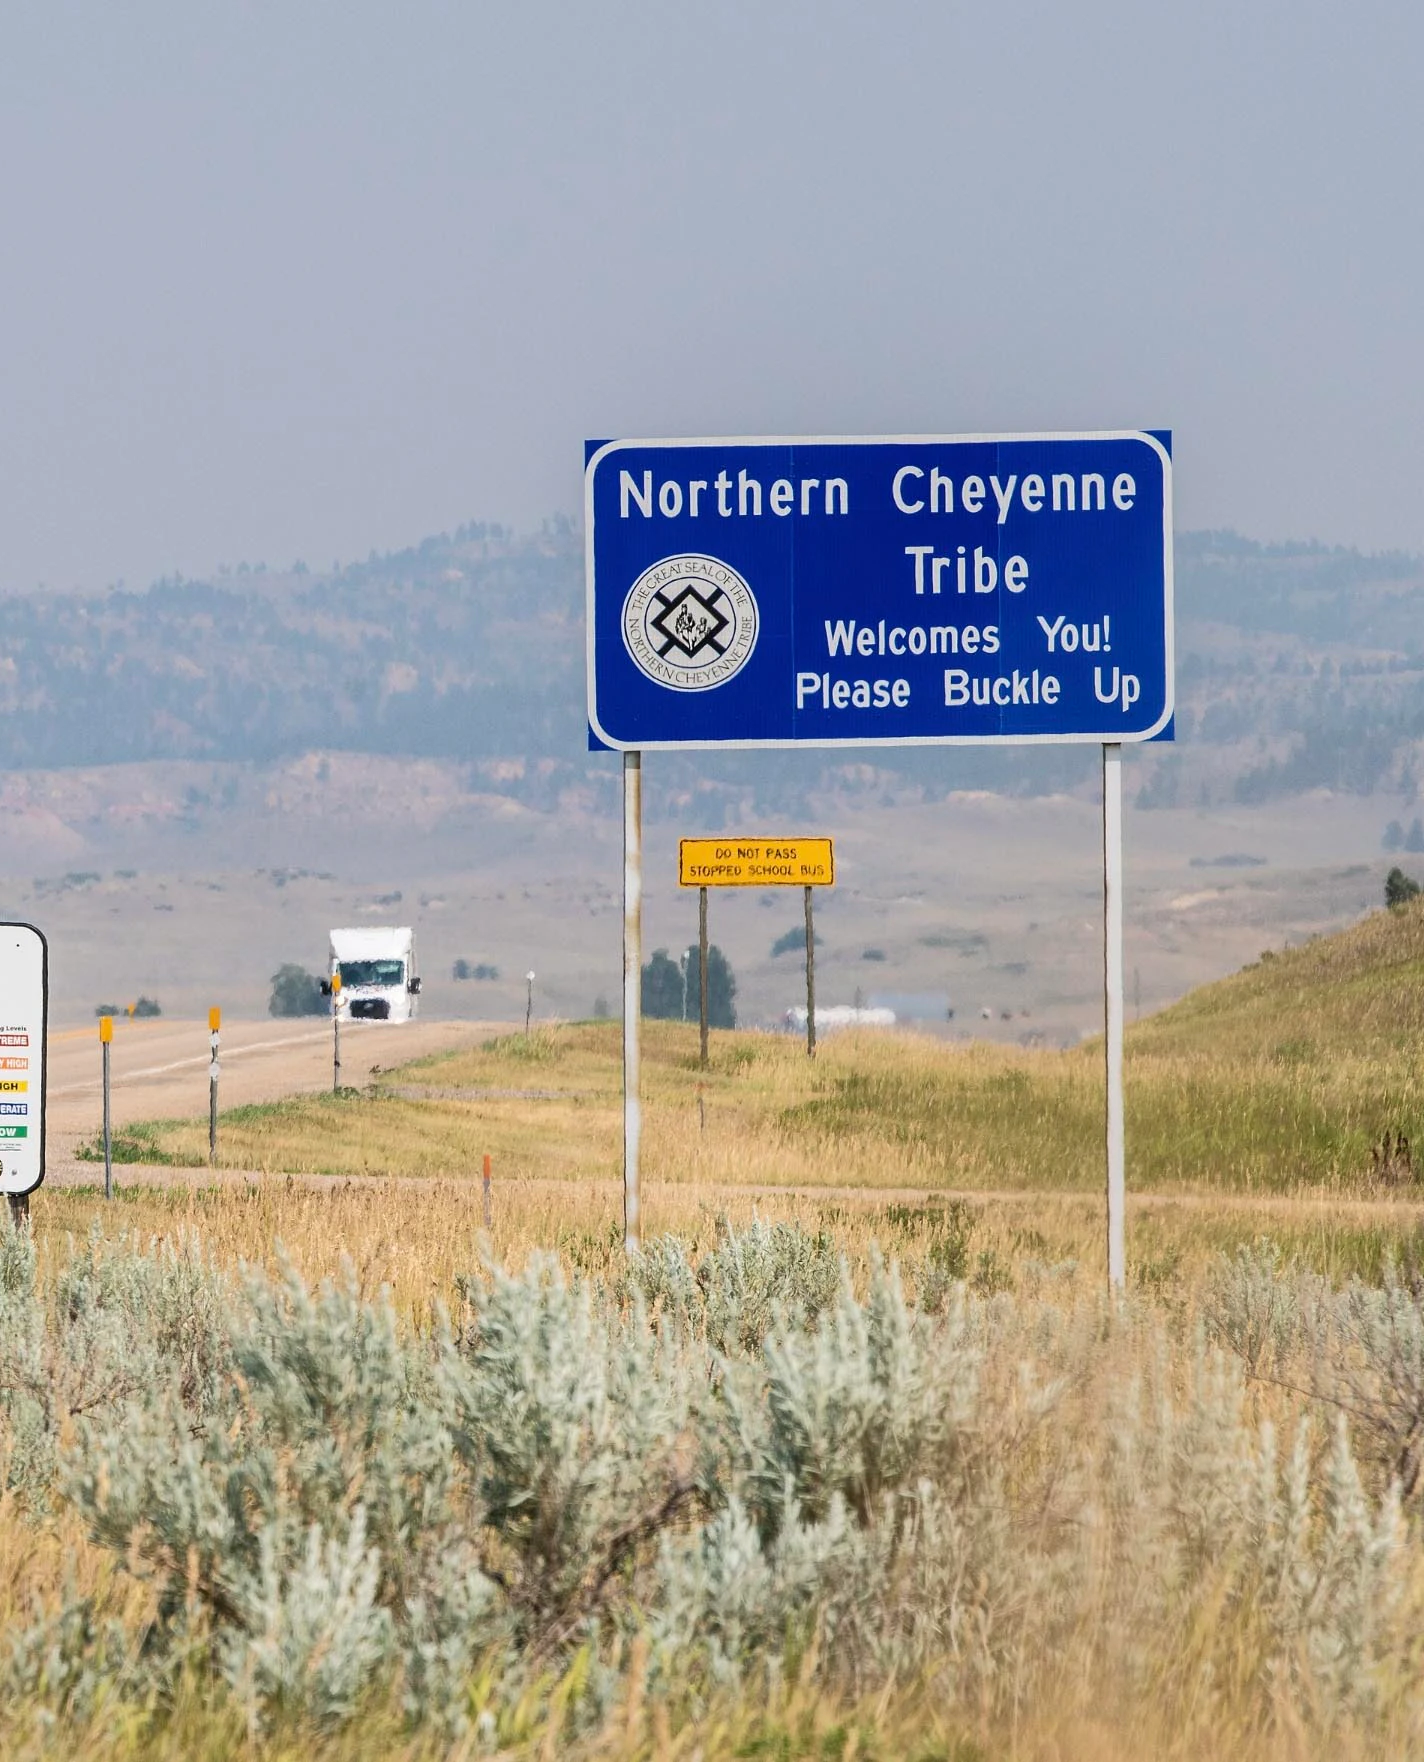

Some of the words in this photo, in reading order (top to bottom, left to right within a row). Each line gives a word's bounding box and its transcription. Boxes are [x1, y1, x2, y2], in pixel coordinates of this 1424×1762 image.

[619, 469, 849, 518] Northern
[892, 465, 1137, 524] Cheyenne
[632, 587, 650, 610] THE
[646, 563, 682, 590] GREAT
[685, 562, 714, 577] SEAL
[715, 569, 732, 585] OF
[729, 581, 748, 608] THE
[904, 545, 1029, 594] Tribe
[629, 618, 676, 680] NORTHERN
[676, 649, 744, 684] CHEYENNE
[738, 615, 753, 648] TRIBE
[824, 619, 1000, 657] Welcomes
[1037, 615, 1111, 653] You!
[797, 673, 911, 710] Please
[944, 669, 1061, 707] Buckle
[1094, 667, 1140, 712] Up
[690, 865, 742, 877] STOPPED
[748, 865, 794, 876] SCHOOL
[800, 864, 824, 876] BUS
[715, 848, 732, 859] DO
[737, 848, 760, 859] NOT
[766, 848, 797, 859] PASS
[6, 1058, 28, 1069] HIGH
